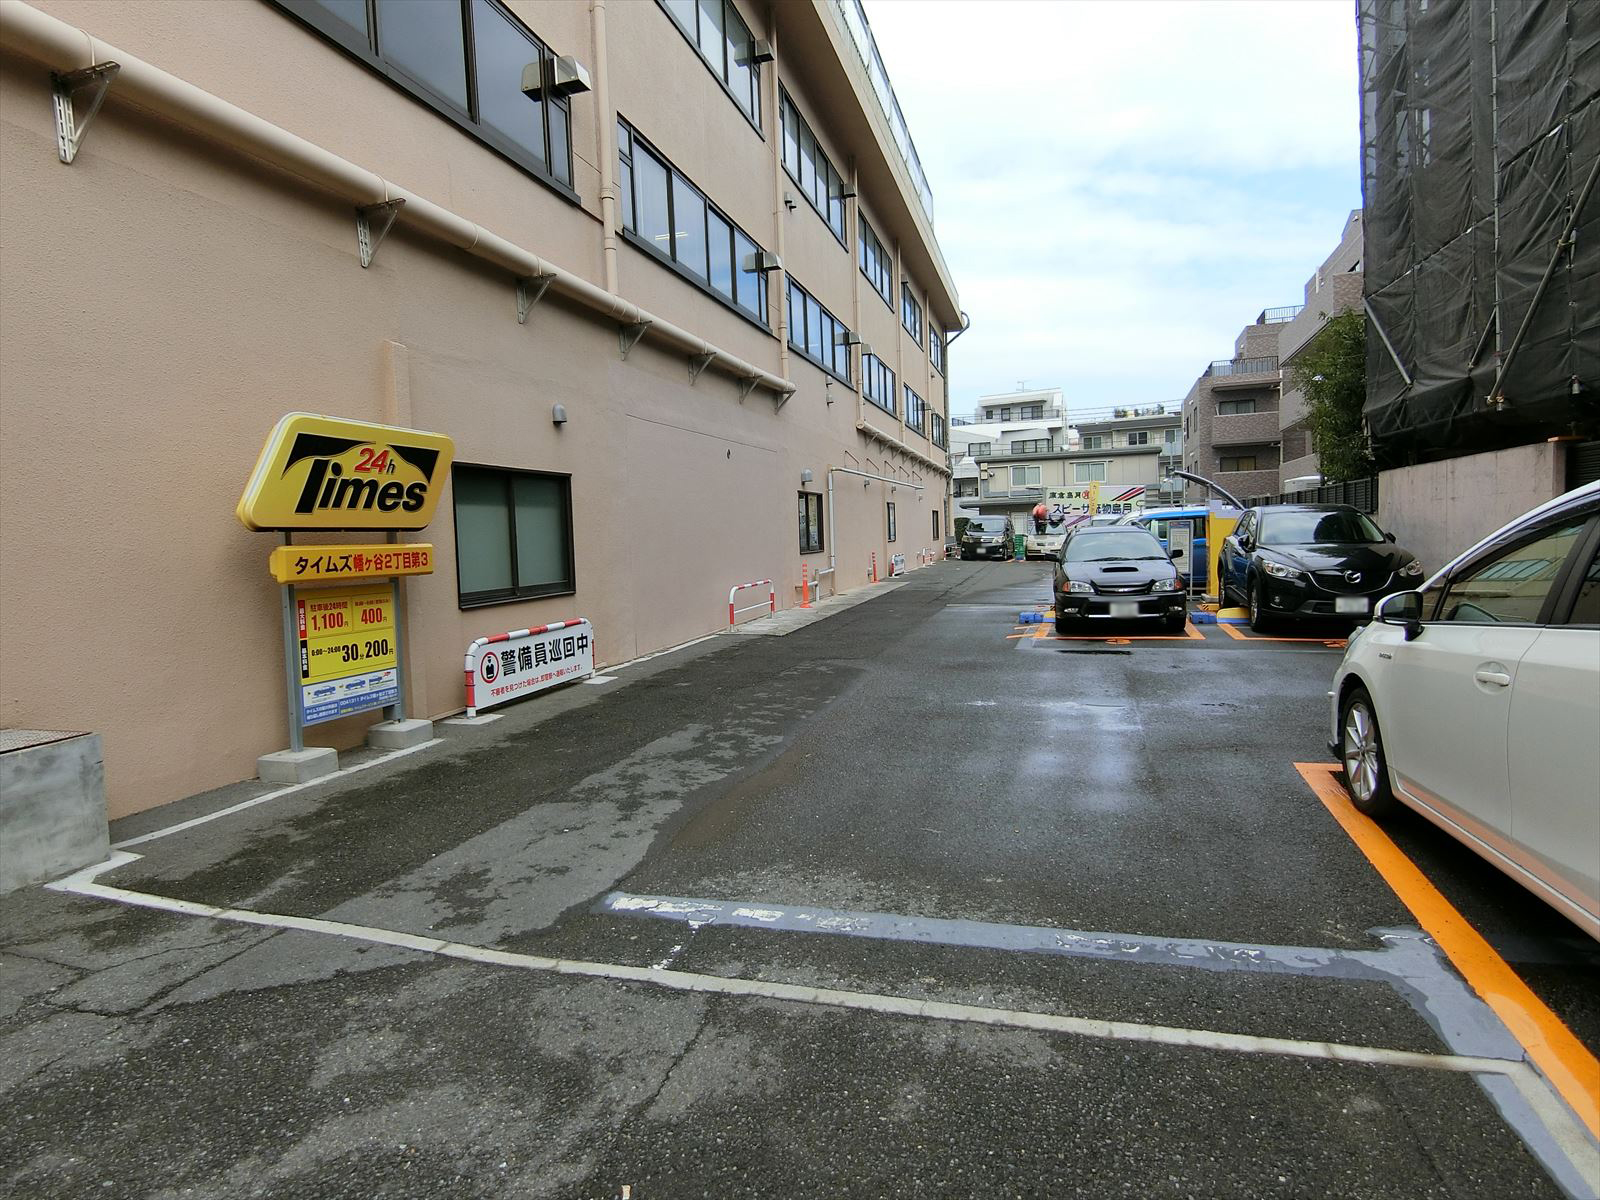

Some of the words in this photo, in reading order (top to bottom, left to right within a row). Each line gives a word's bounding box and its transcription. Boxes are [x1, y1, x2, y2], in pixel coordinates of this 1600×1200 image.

[282, 436, 430, 514] Times
[500, 632, 589, 677] 警備員巡回中
